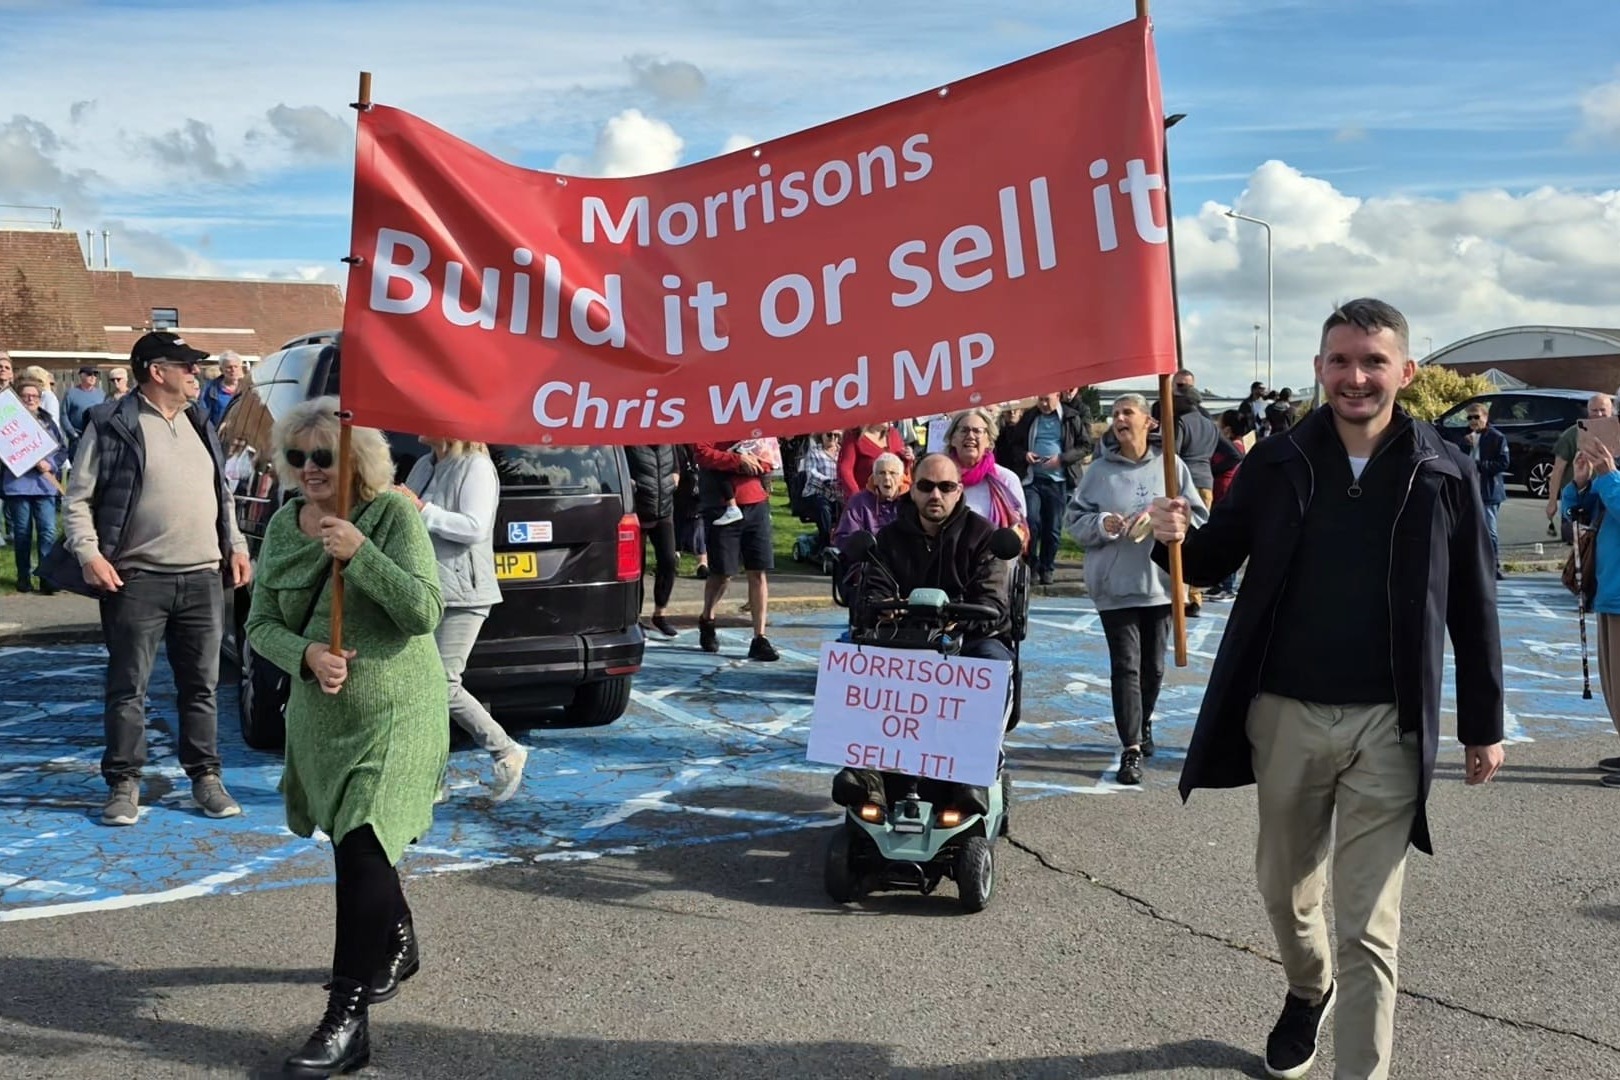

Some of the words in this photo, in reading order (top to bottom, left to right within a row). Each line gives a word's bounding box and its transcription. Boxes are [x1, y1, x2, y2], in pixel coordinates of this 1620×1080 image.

[581, 133, 934, 247] Morrisons
[369, 226, 627, 349] Build
[661, 274, 730, 356] it
[759, 257, 857, 338] or
[888, 176, 1057, 308] sell
[1088, 158, 1168, 252] it
[532, 381, 686, 429] Chris
[708, 356, 869, 425] Ward
[893, 332, 995, 400] MP
[827, 650, 992, 690] MORRISONS
[845, 685, 928, 715] BUILD
[937, 696, 966, 720] IT
[882, 715, 920, 741] OR
[845, 743, 908, 772] SELL
[918, 752, 955, 779] IT!
